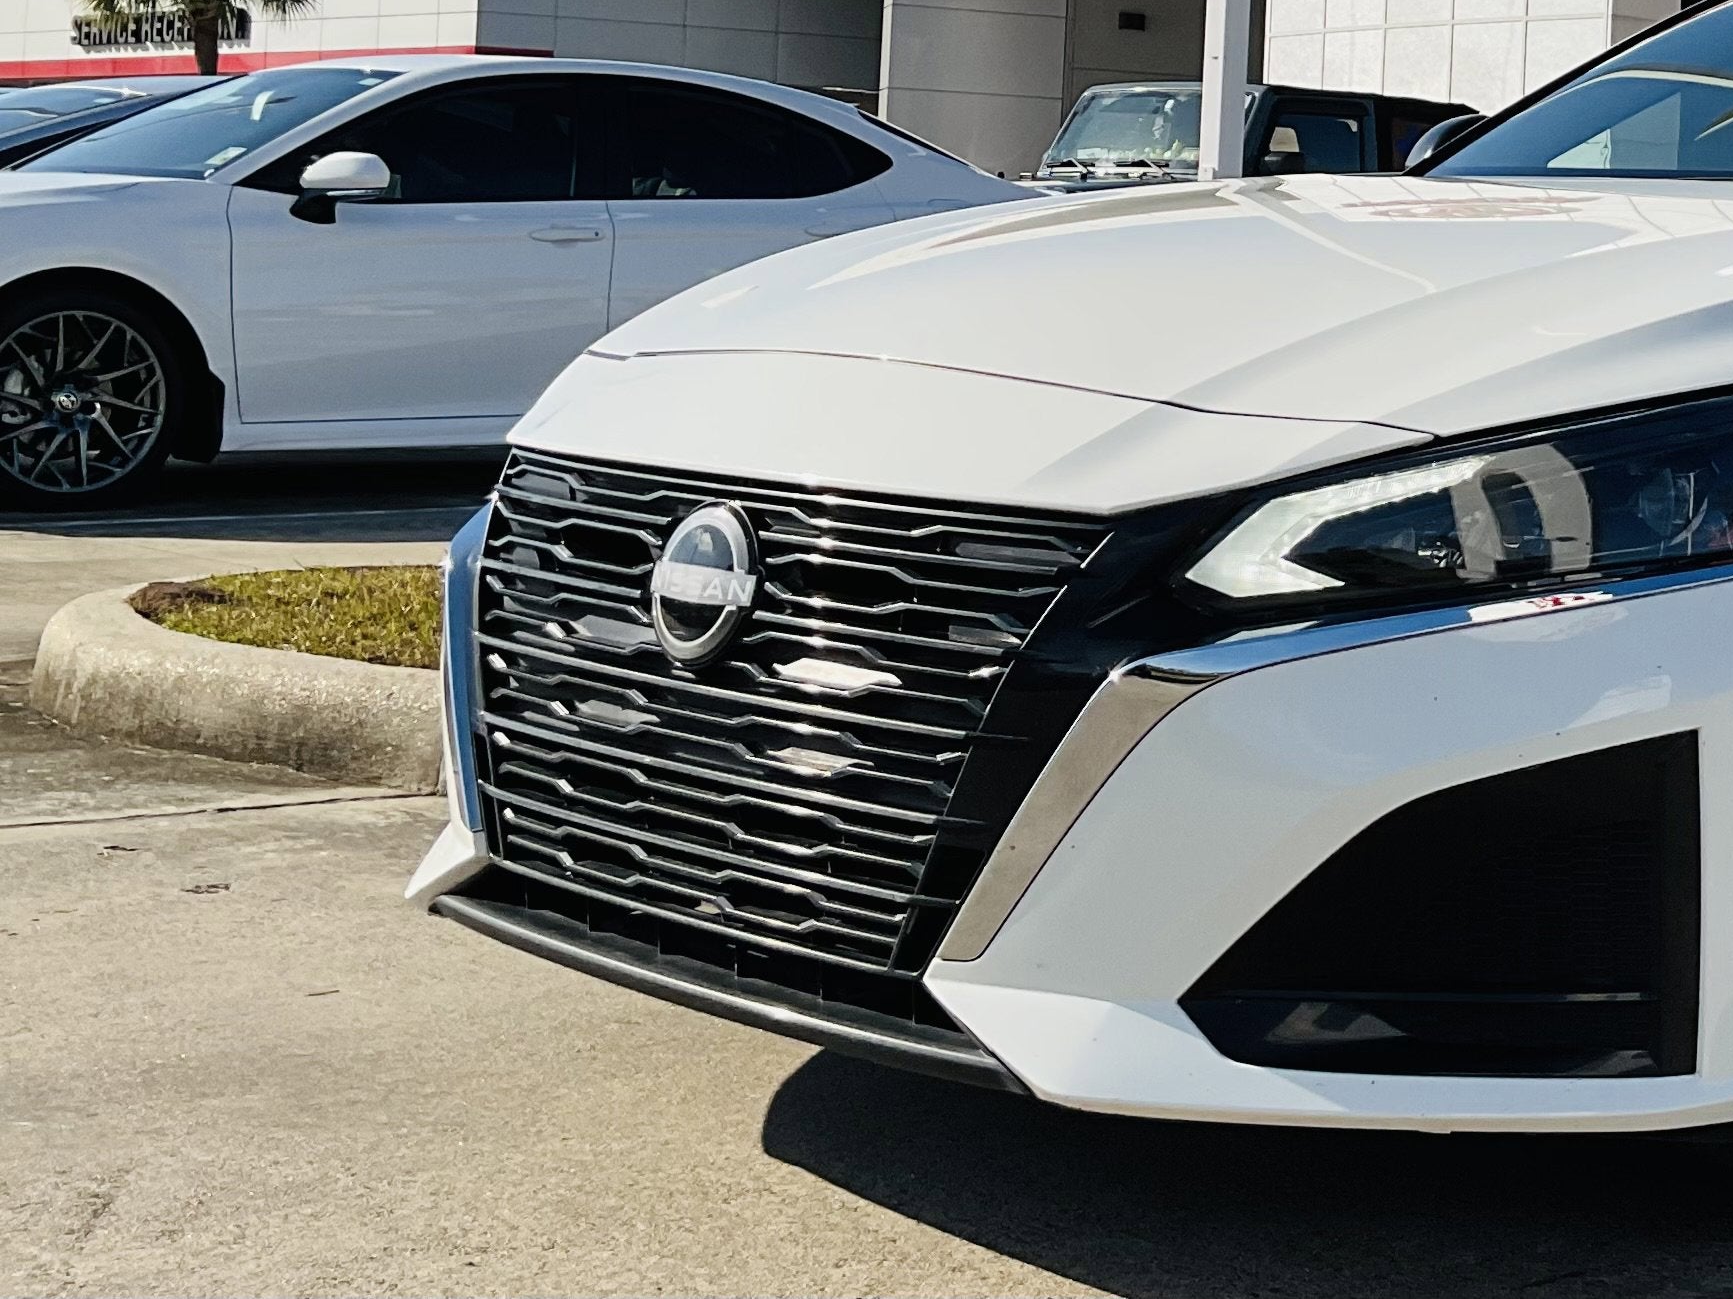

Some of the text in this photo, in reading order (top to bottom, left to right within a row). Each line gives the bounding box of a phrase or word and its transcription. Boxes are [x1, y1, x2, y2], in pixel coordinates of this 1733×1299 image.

[71, 6, 238, 46] SERVICE RECEN
[652, 565, 753, 603] NISSAN
